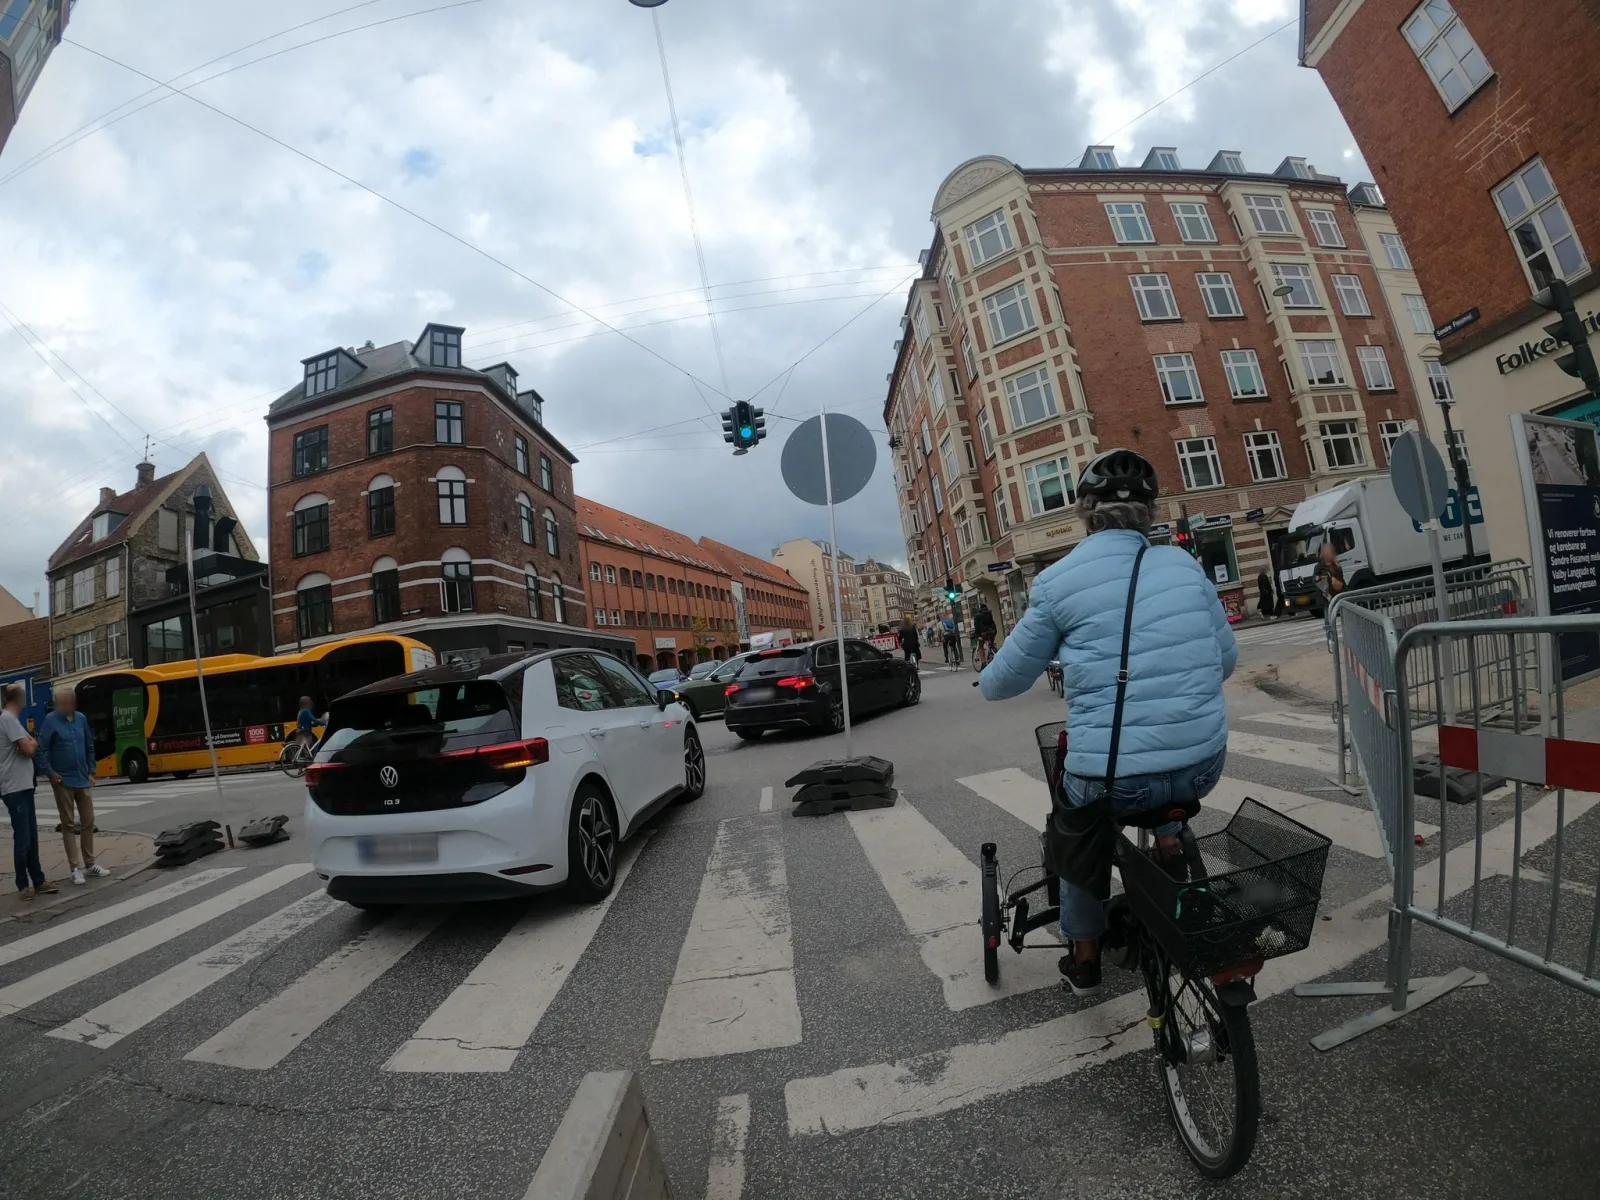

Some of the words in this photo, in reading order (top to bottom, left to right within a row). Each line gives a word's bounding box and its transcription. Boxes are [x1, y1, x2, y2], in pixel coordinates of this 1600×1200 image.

[1046, 526, 1072, 538] apotek
[1443, 534, 1452, 542] WE
[1547, 529, 1554, 538] Vi
[1554, 530, 1579, 538] renoverer
[1579, 527, 1596, 537] fortove
[1549, 544, 1557, 554] og
[1556, 541, 1580, 551] kørebane
[1580, 540, 1587, 552] på
[1550, 556, 1570, 566] Søndre
[1569, 553, 1590, 564] Fasanvej
[1552, 569, 1566, 581] Valby
[1567, 567, 1589, 578] Langgade
[1589, 567, 1596, 576] og
[1553, 580, 1597, 593] kommunegrænsen
[249, 728, 264, 736] 1000
